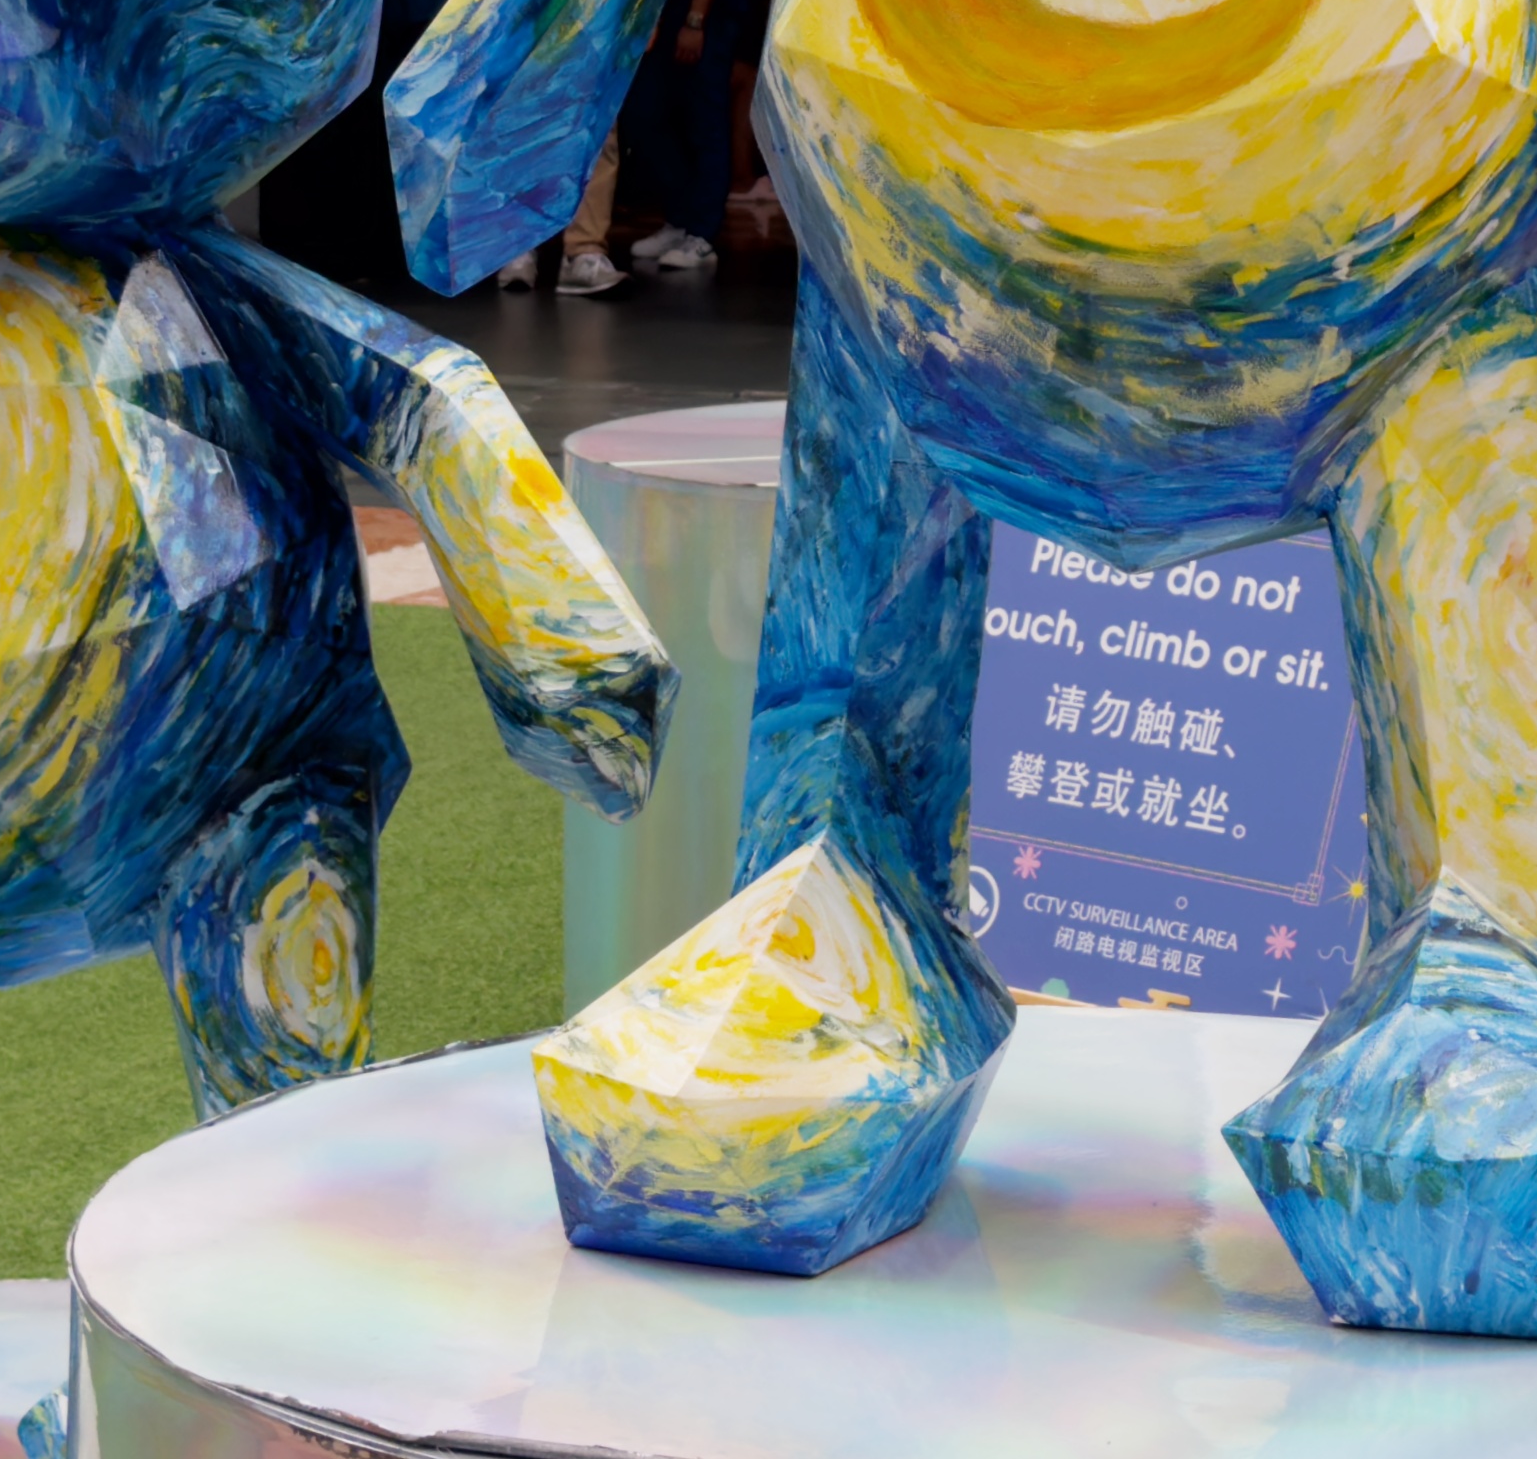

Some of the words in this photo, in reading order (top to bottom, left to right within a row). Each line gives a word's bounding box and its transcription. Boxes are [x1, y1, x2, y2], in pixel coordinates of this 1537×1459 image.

[1166, 560, 1221, 600] do
[1231, 576, 1301, 613] not
[983, 606, 1084, 654] ouch,
[1100, 620, 1211, 669] climb
[1223, 645, 1267, 678] or
[1276, 649, 1329, 691] sit.
[1044, 683, 1235, 758] 请勿触碰、
[1007, 750, 1247, 839] 攀登或就坐。
[1023, 892, 1067, 916] CCTV
[1069, 900, 1189, 942] SURVEILLANCE
[1192, 930, 1239, 952] AREA
[1054, 925, 1205, 977] 闭路电视监视区
